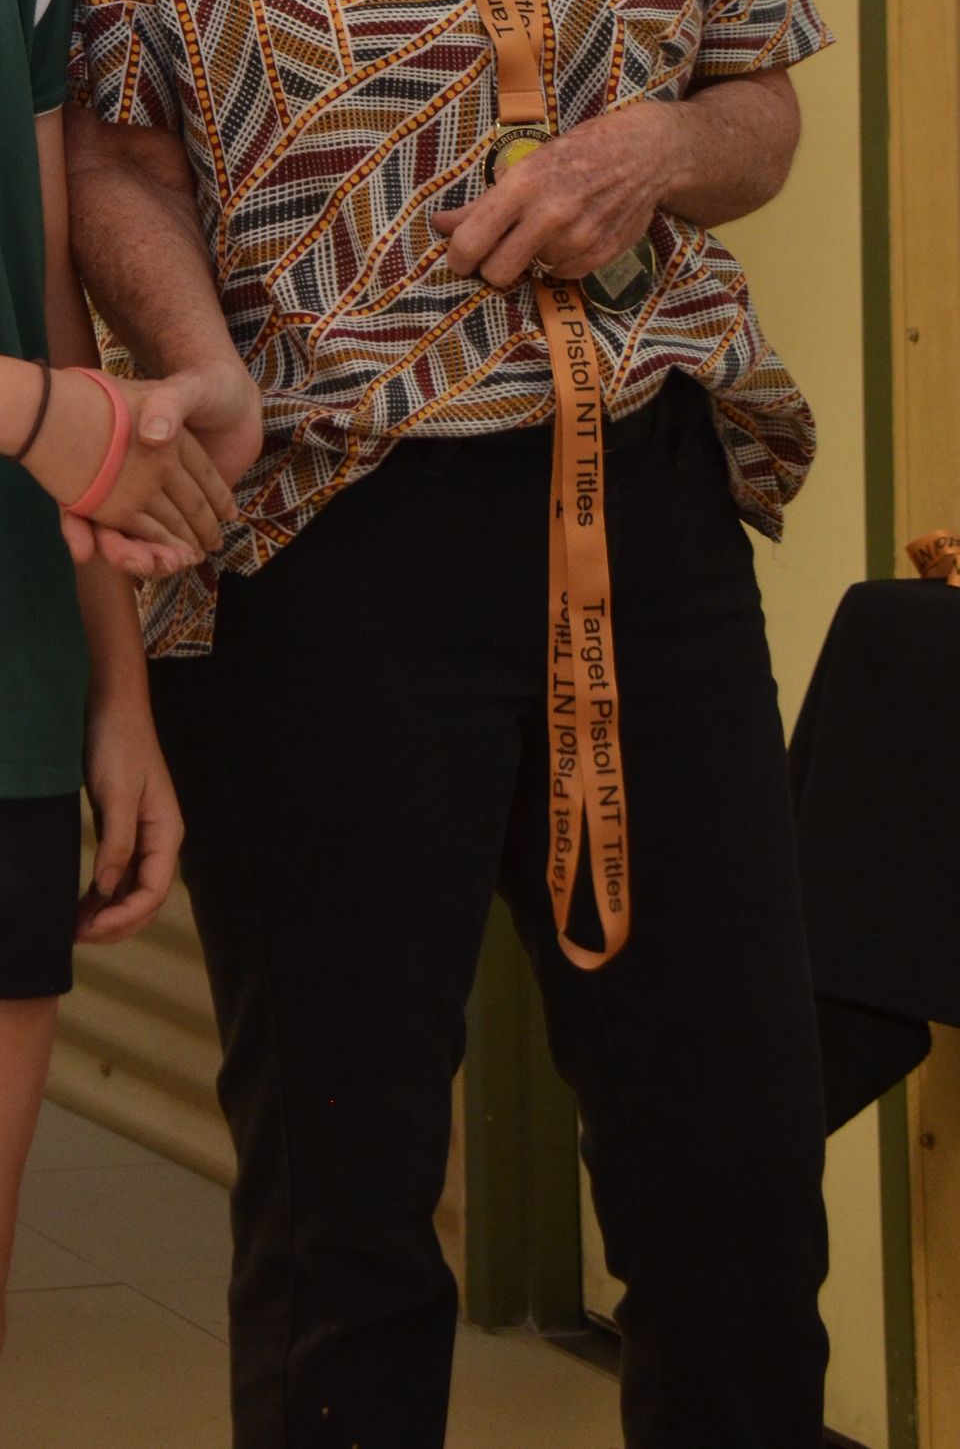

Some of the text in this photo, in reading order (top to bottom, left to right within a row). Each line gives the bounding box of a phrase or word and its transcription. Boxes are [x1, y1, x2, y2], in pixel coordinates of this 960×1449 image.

[492, 130, 525, 151] TARGET
[561, 320, 595, 392] Pistol
[576, 401, 598, 442] NT
[576, 452, 599, 528] Titles
[553, 676, 576, 716] NT
[553, 724, 577, 799] Pistol
[581, 597, 623, 915] Target Pistol NT Titles
[551, 808, 572, 896] Target
